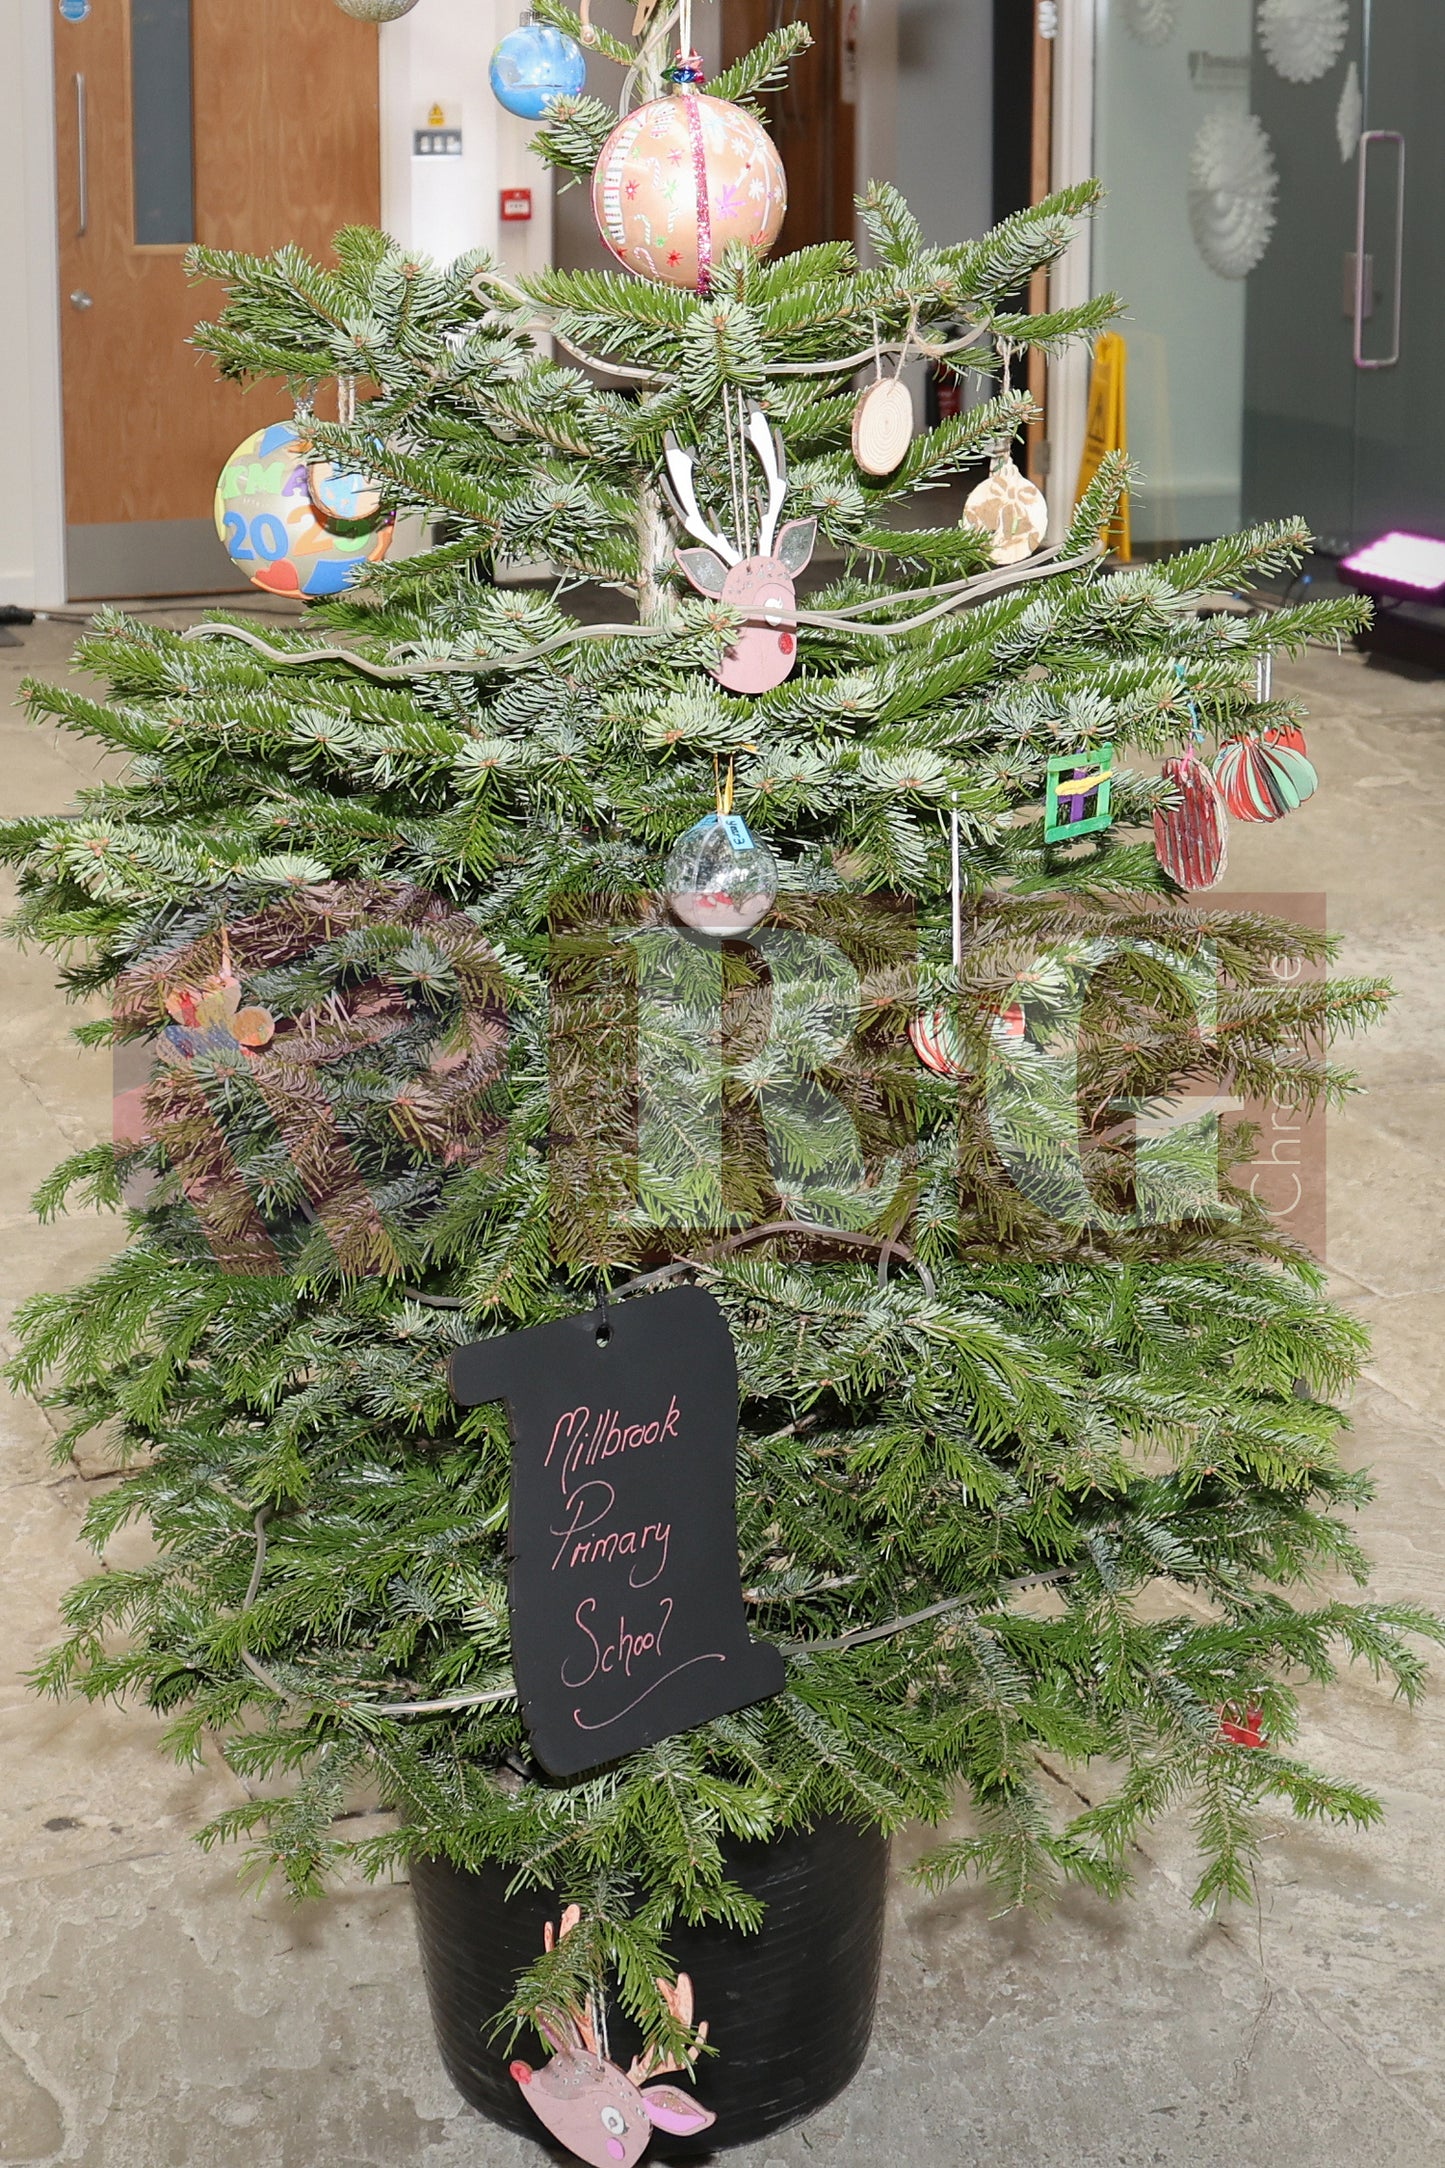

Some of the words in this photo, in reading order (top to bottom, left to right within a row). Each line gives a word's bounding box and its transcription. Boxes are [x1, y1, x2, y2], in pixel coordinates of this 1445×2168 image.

[222, 462, 312, 499] XMA
[544, 1395, 680, 1494] Millbrook
[550, 1480, 671, 1588] Primary
[561, 1598, 673, 1687] School
